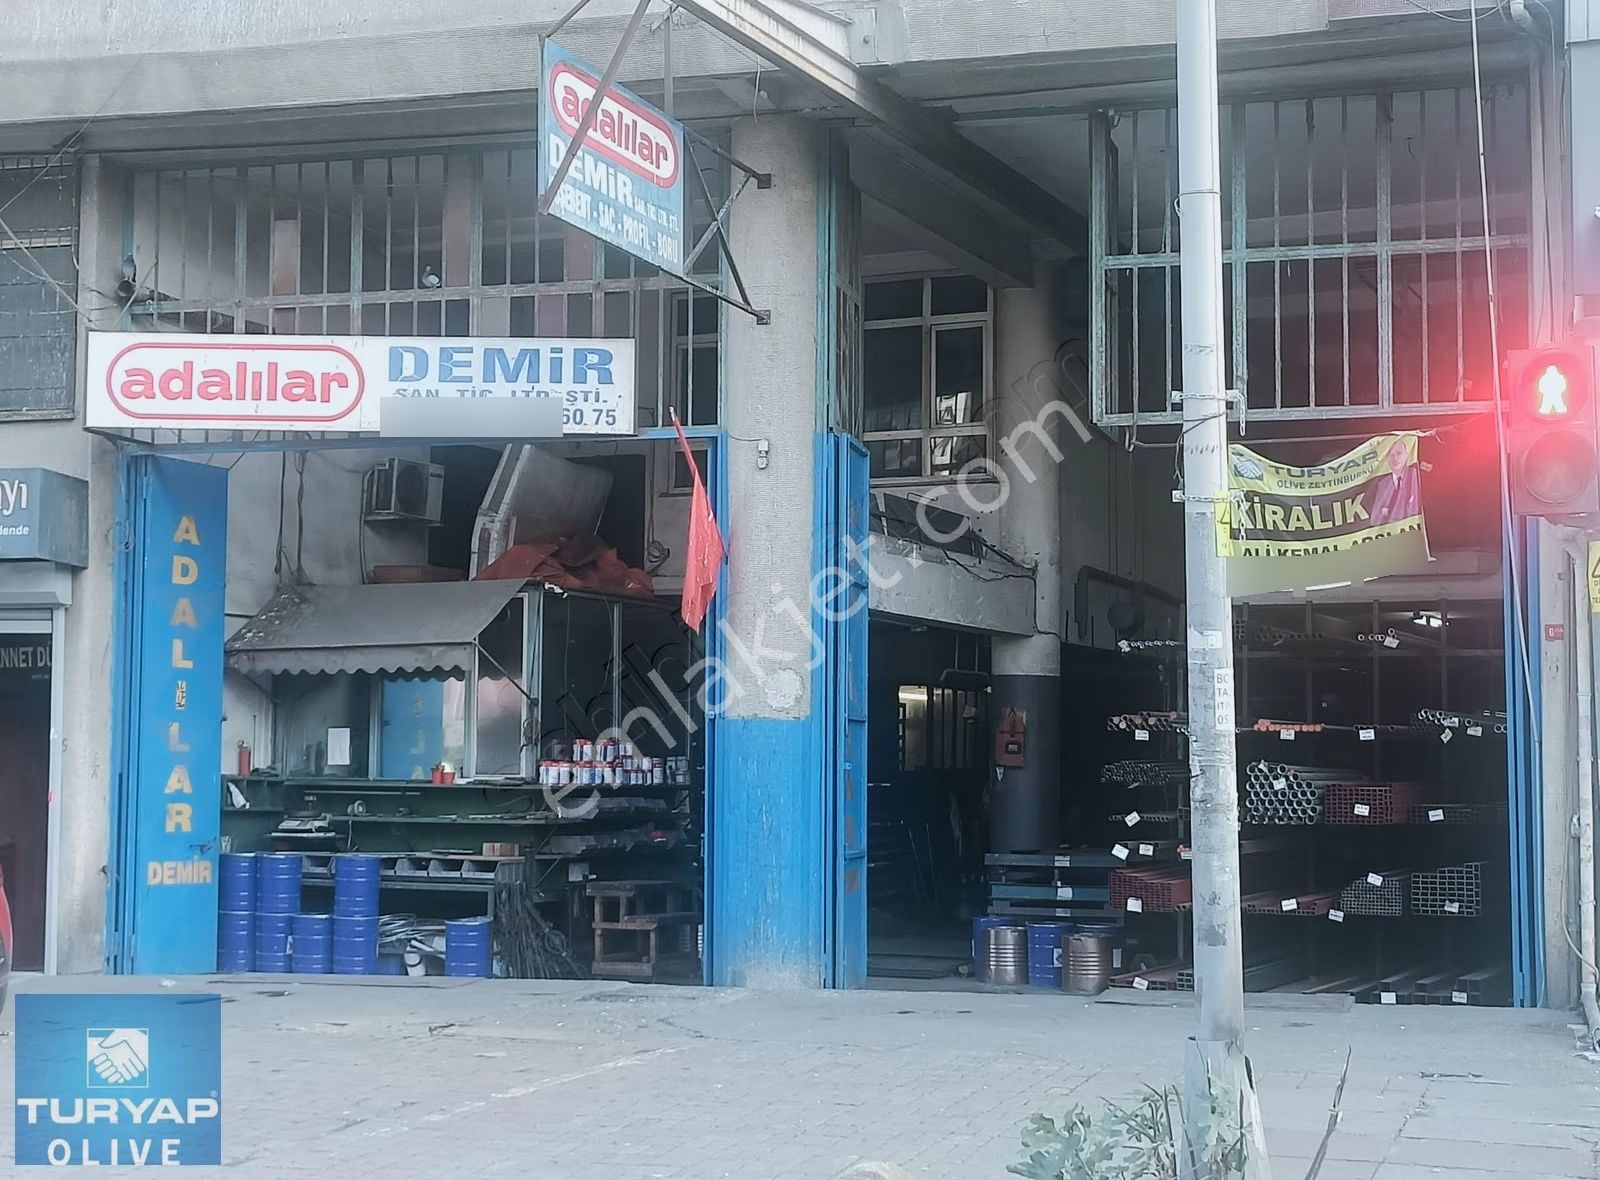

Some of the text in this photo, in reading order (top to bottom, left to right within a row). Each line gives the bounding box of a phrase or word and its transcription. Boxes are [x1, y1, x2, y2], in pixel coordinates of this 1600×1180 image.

[598, 201, 616, 234] SAC
[117, 360, 350, 404] adalılar
[1269, 450, 1379, 478] TURYAP
[1230, 492, 1371, 532] KİRALIK
[147, 856, 213, 886] DEMİR
